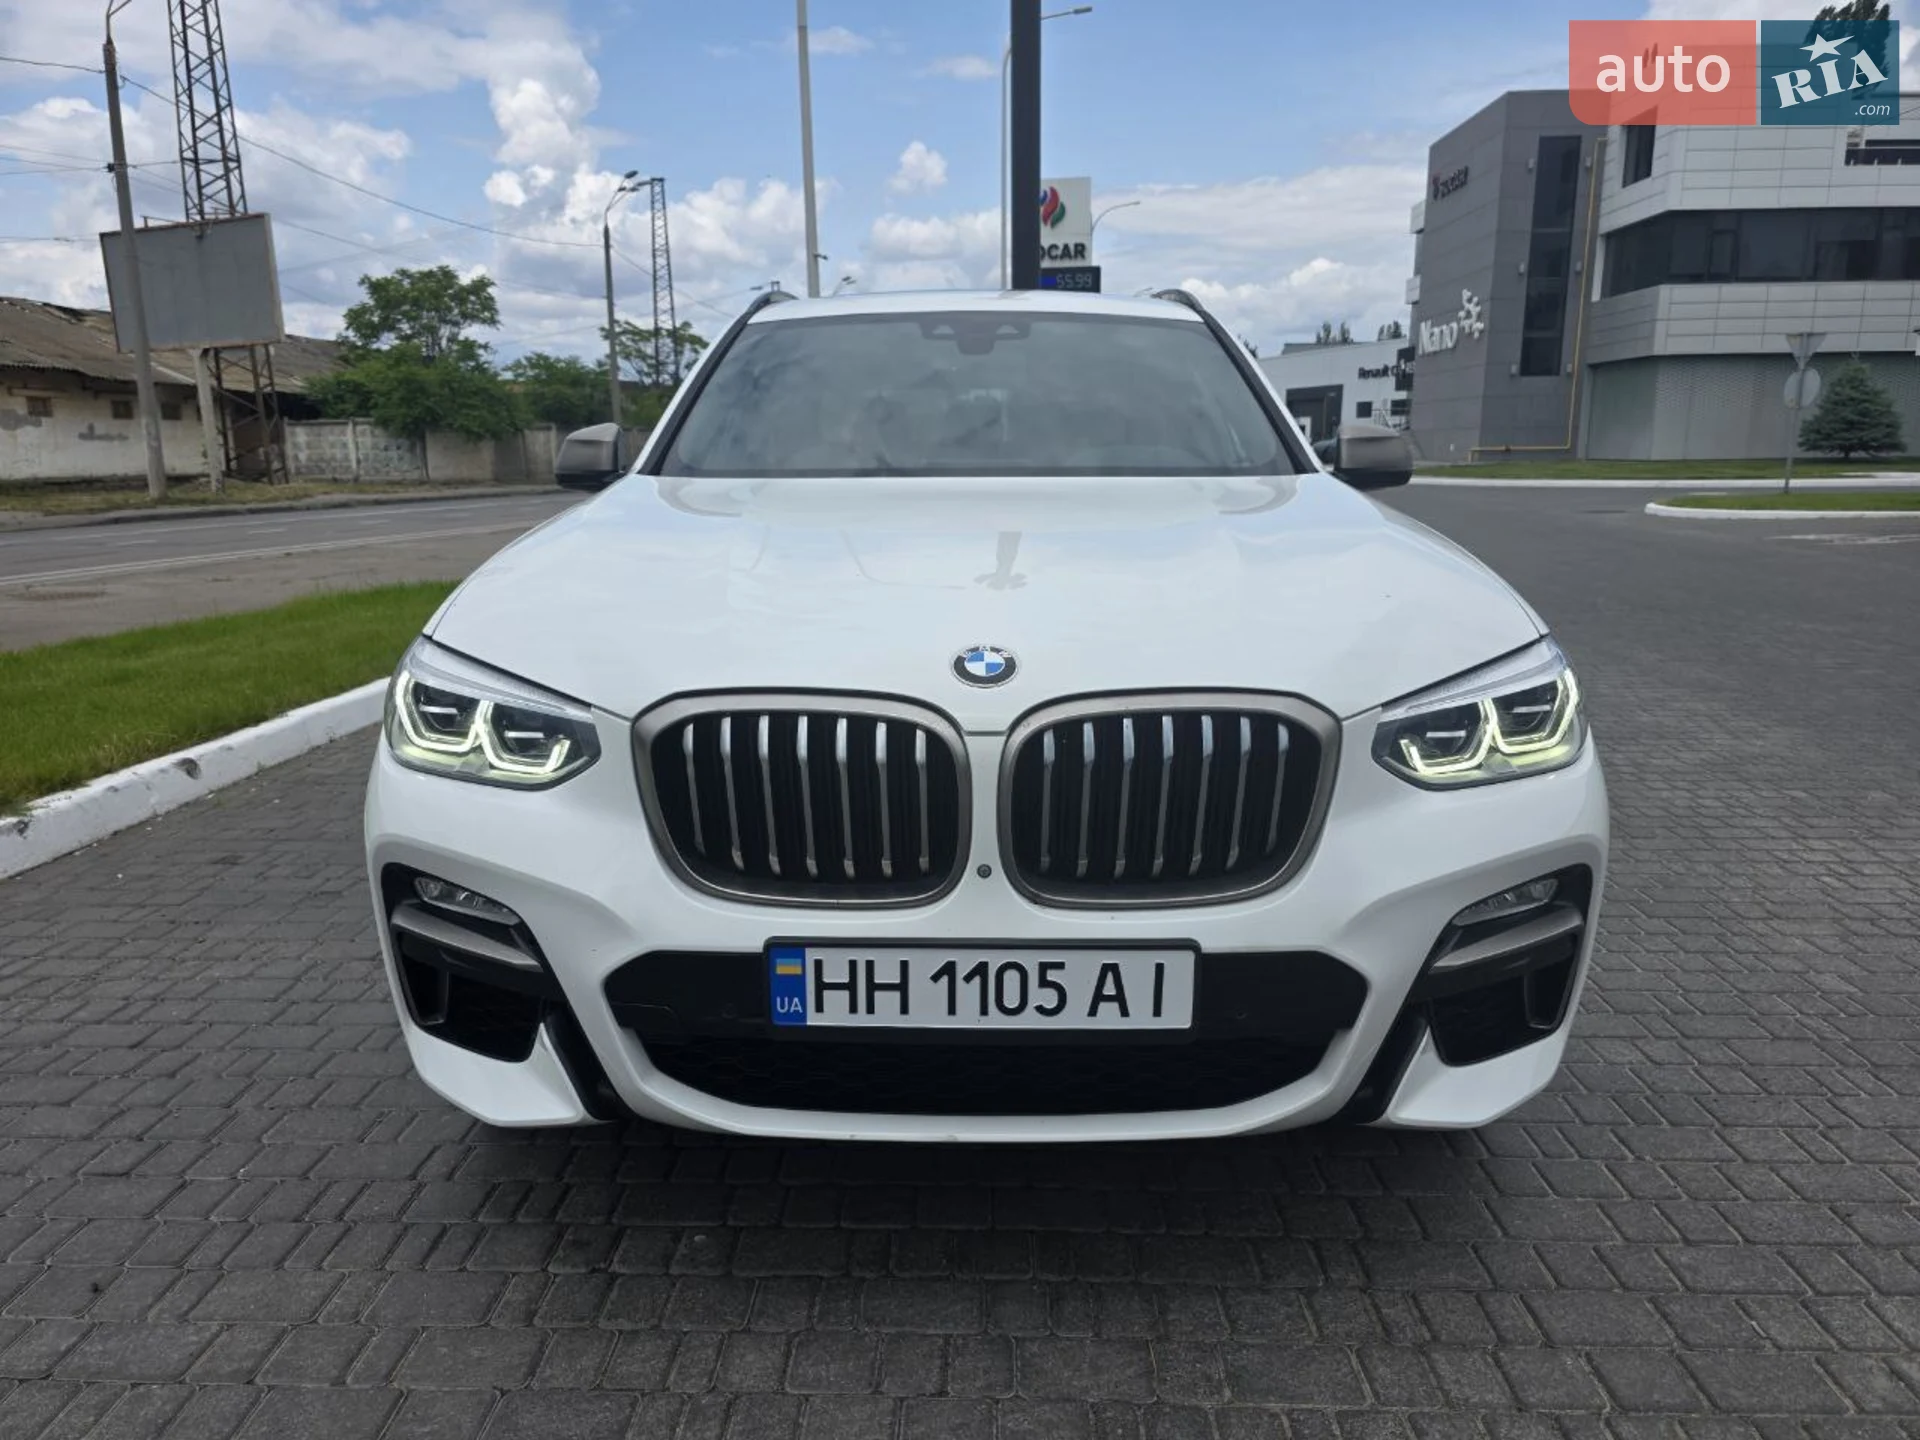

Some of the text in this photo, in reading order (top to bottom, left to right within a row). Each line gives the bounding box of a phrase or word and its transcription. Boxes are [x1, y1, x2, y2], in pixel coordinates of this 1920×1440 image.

[1418, 319, 1459, 356] Nano
[776, 996, 803, 1013] UA
[814, 958, 909, 1016] HH
[929, 959, 1068, 1018] 1105
